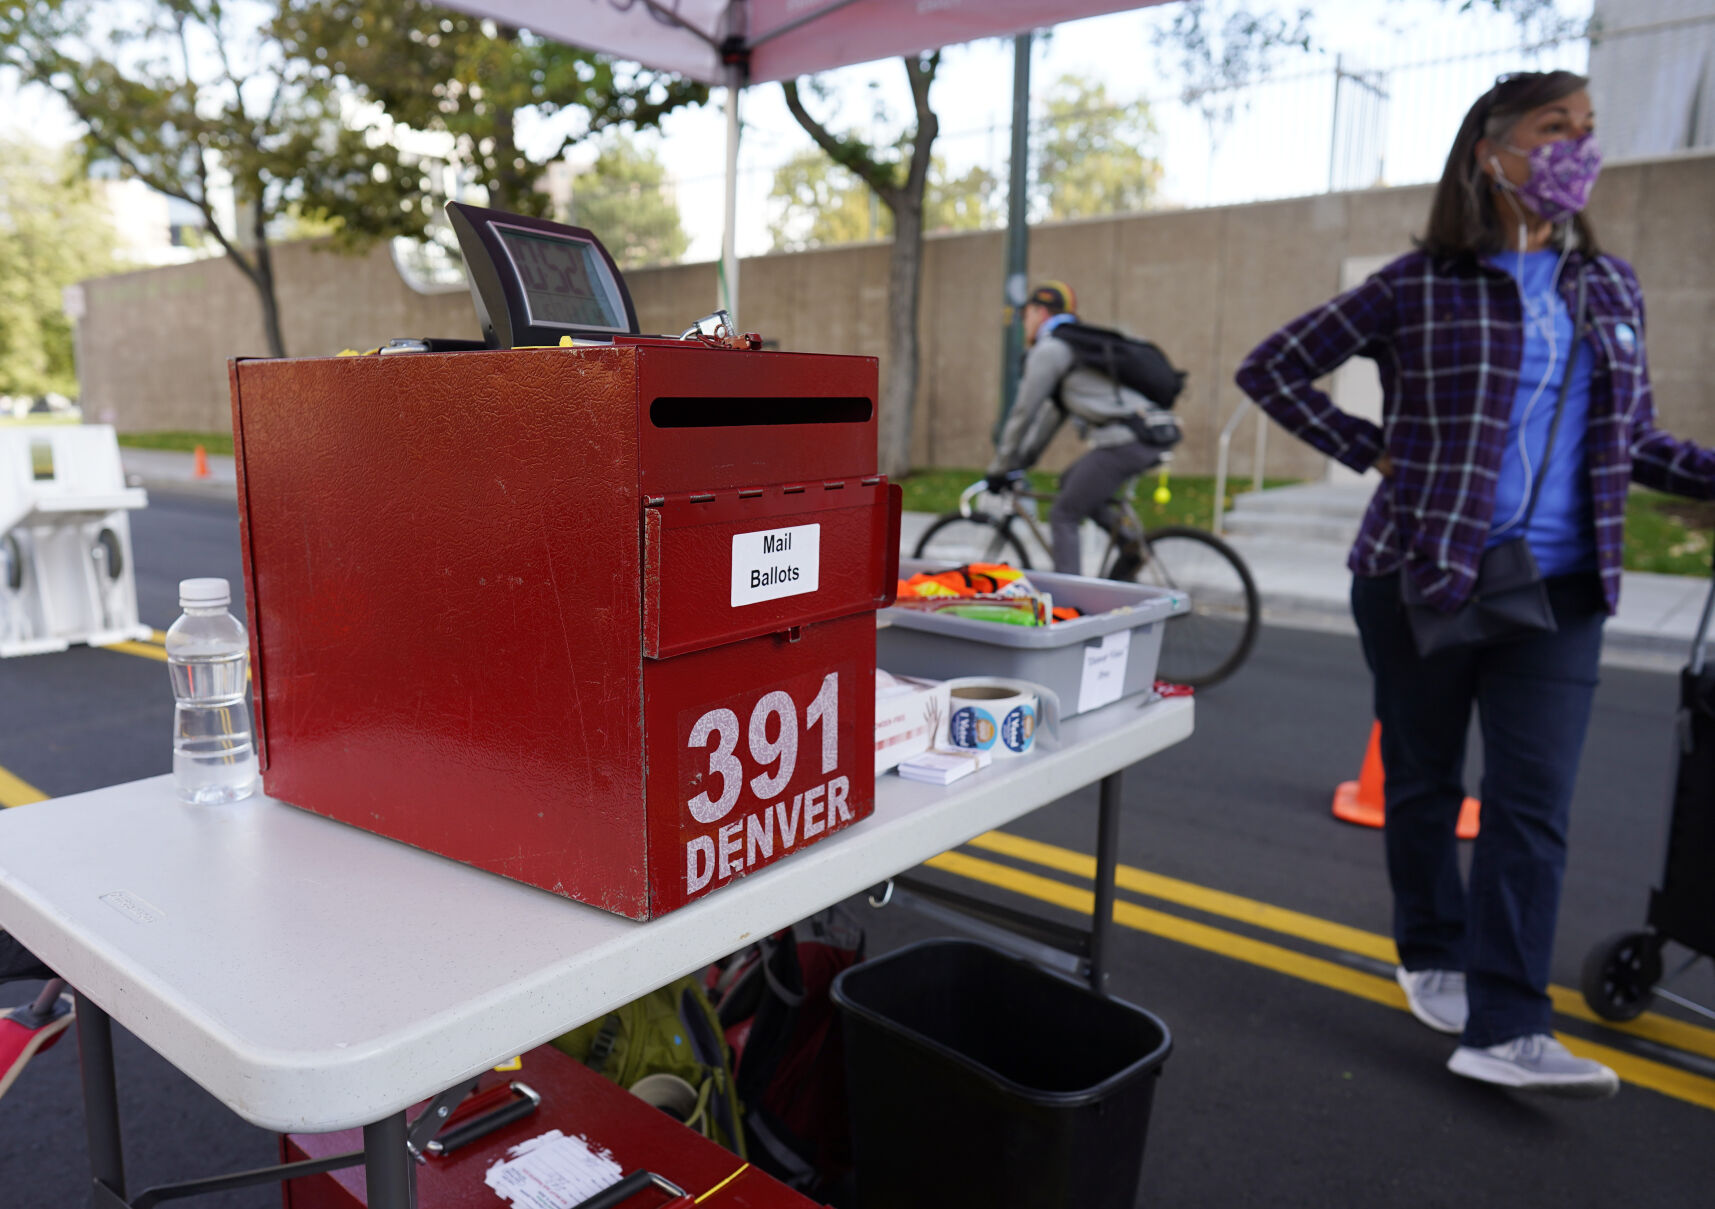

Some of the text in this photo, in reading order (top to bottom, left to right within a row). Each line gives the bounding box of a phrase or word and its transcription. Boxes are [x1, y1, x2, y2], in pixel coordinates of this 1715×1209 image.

[763, 532, 792, 554] Mail
[750, 564, 800, 589] Ballots
[687, 671, 839, 824] 391
[1010, 718, 1021, 748] Voted
[686, 775, 853, 896] DENVER
